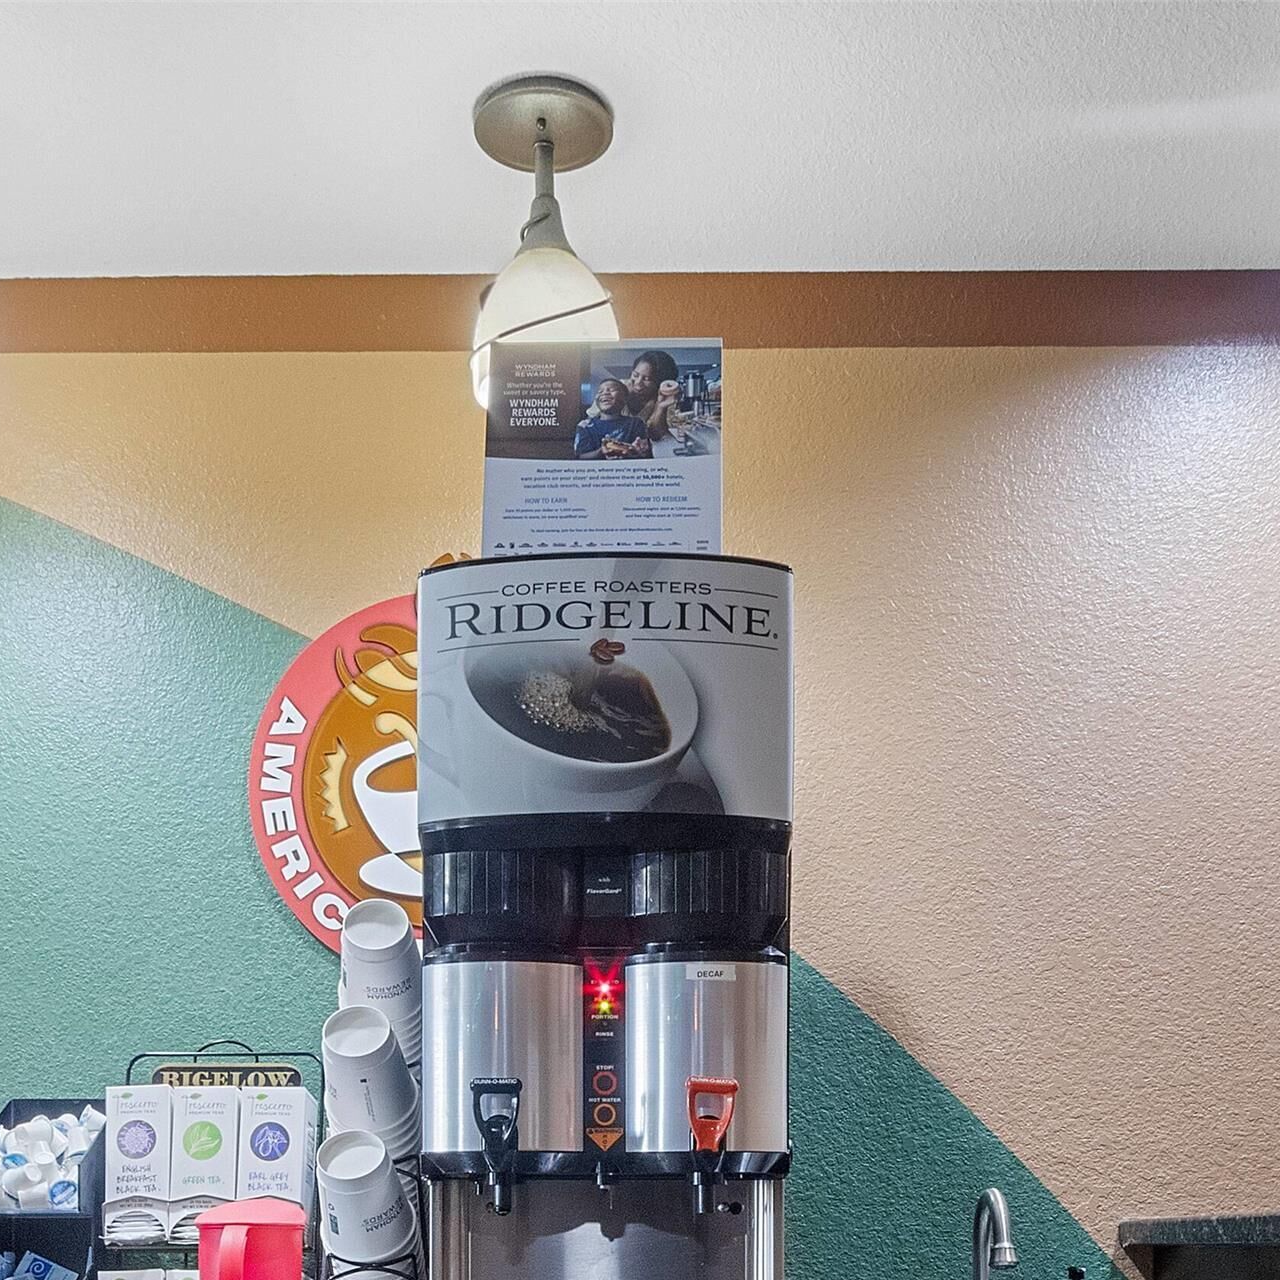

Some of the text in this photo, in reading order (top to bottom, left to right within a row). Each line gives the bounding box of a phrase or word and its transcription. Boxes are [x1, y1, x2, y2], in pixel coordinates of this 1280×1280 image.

[509, 399, 559, 408] WYNDHAM
[511, 408, 557, 417] REWARDS
[509, 417, 560, 427] EVERYONE.
[502, 580, 712, 597] COFFEE ROASTERS
[259, 695, 349, 931] AMERIC
[696, 970, 724, 978] DECAF
[367, 983, 413, 1000] WYNDHAM
[160, 1071, 295, 1087] BIGELOW
[116, 1174, 158, 1183] BREAKFAST
[182, 1175, 206, 1185] GREEN
[248, 1171, 289, 1181] EARL GREY
[116, 1184, 140, 1194] BLACK
[248, 1182, 272, 1191] BLACK
